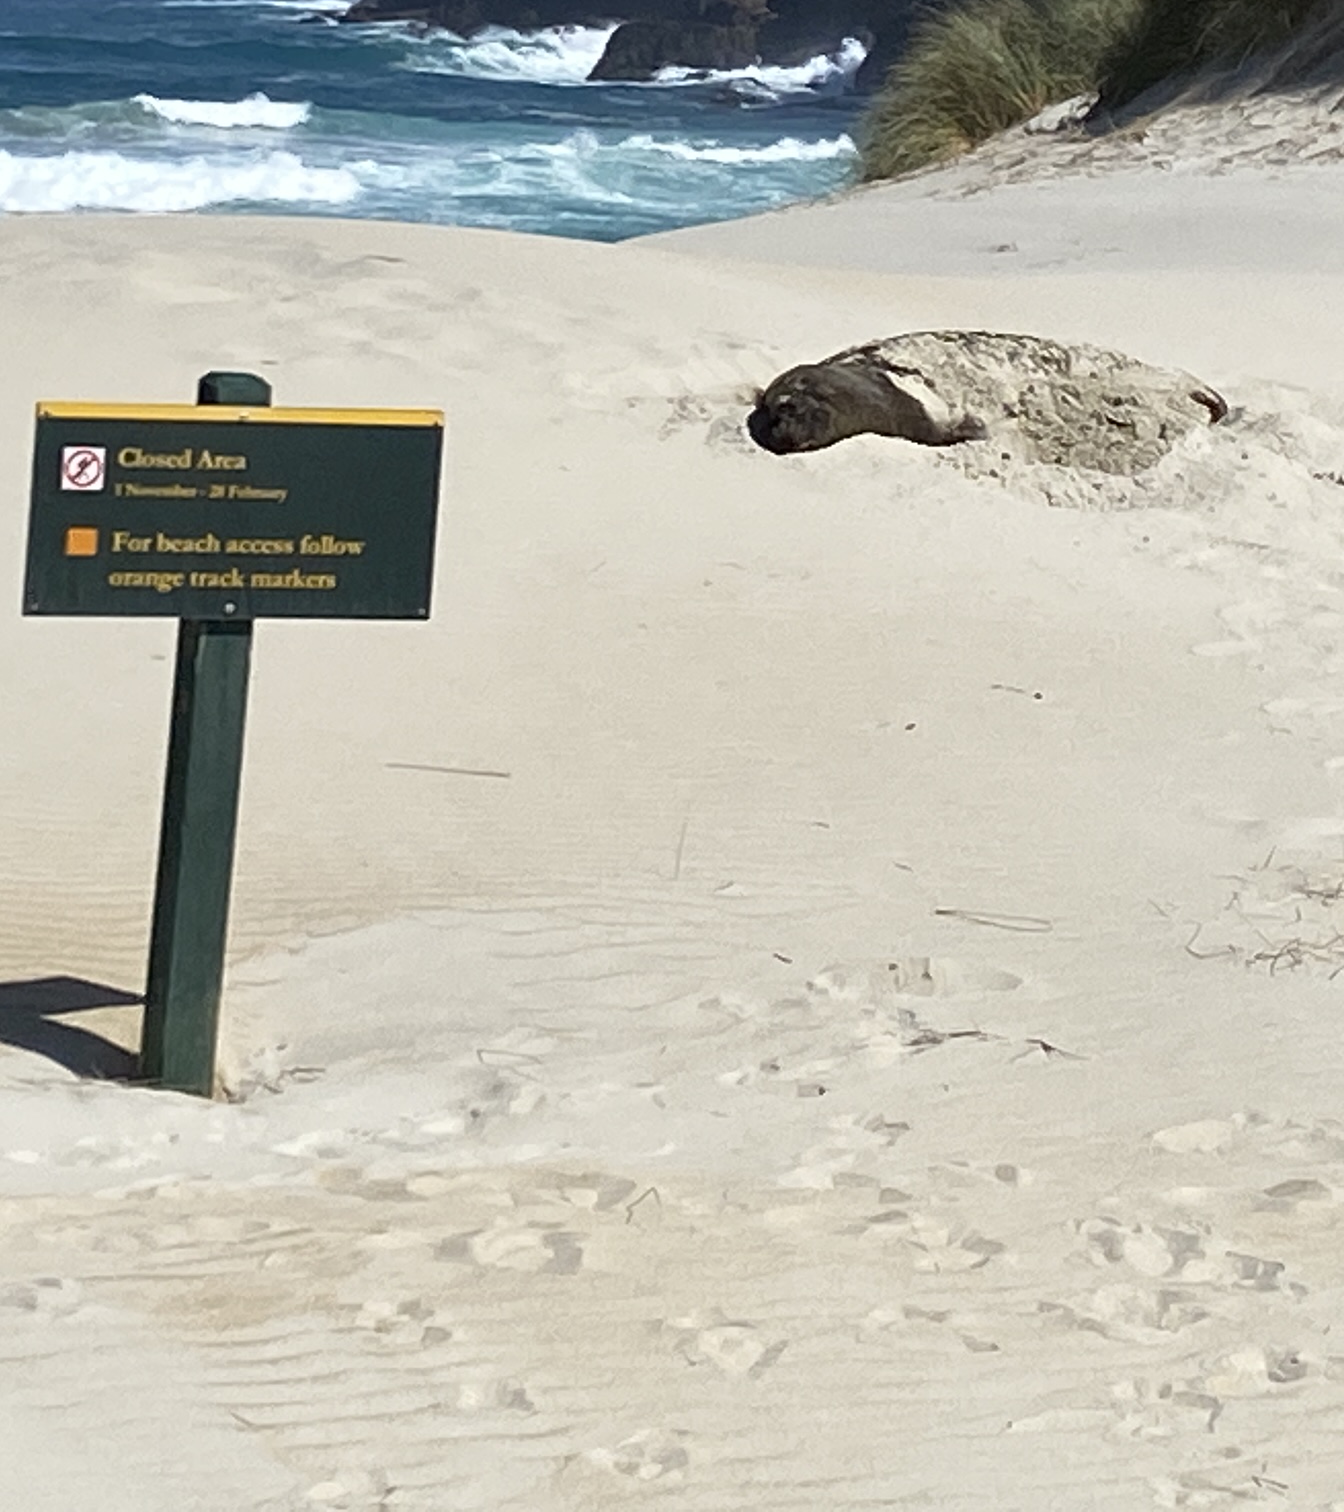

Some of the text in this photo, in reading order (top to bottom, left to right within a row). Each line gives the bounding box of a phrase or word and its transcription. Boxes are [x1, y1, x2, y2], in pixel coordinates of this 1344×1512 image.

[117, 447, 246, 470] Closed Area
[124, 483, 197, 498] November
[208, 484, 225, 499] 28
[228, 485, 288, 503] February
[111, 531, 366, 555] For beach access follow
[108, 568, 336, 592] orange track markers
